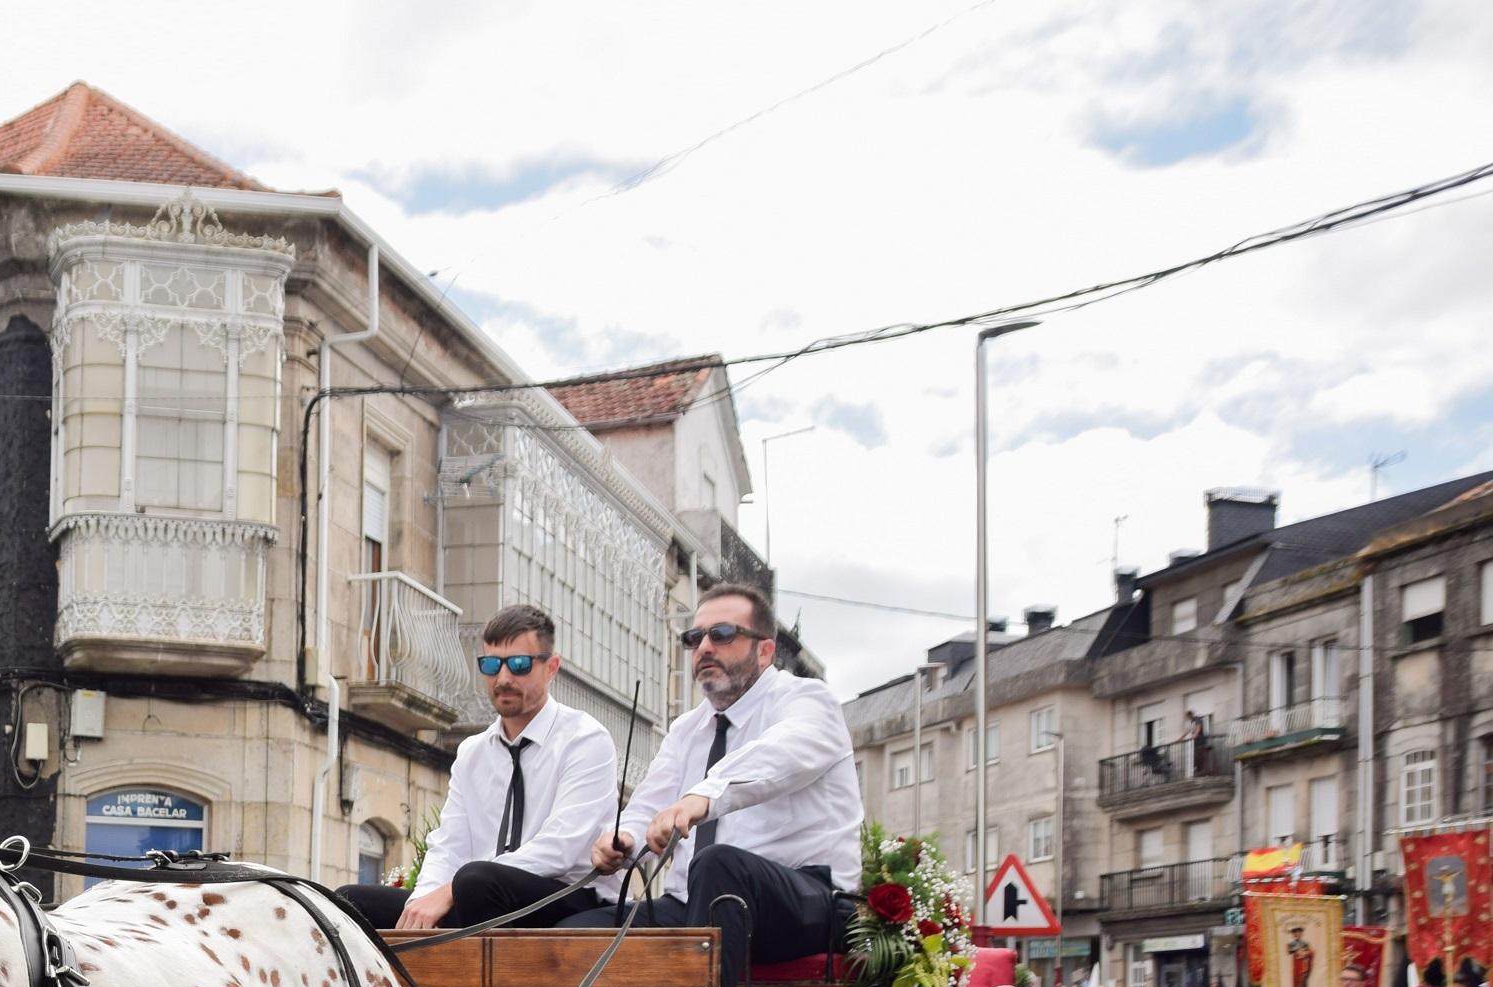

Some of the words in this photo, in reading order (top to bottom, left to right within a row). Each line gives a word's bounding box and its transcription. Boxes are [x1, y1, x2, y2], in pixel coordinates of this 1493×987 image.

[117, 793, 172, 806] IMPRENTA
[102, 805, 133, 817] CASA
[137, 806, 187, 818] BACELAR
